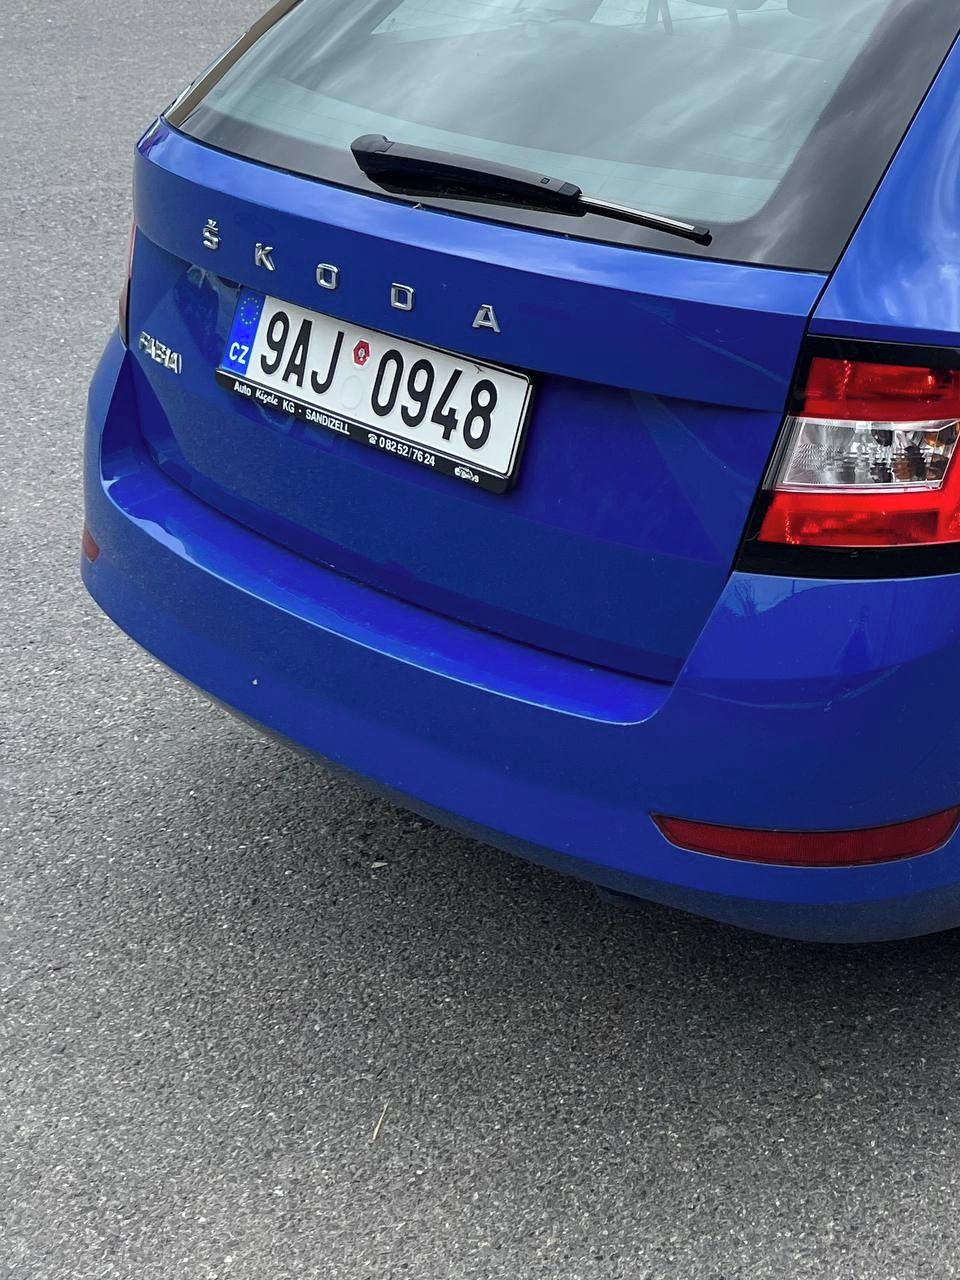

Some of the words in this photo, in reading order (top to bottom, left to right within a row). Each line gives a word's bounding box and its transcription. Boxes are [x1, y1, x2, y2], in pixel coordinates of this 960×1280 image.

[203, 219, 501, 333] ŠKODA
[229, 342, 250, 365] CZ
[260, 311, 345, 395] 9AJ
[371, 349, 498, 450] 0948
[233, 381, 252, 397] Auto
[282, 399, 296, 414] KG
[305, 408, 351, 436] SANDIZELL
